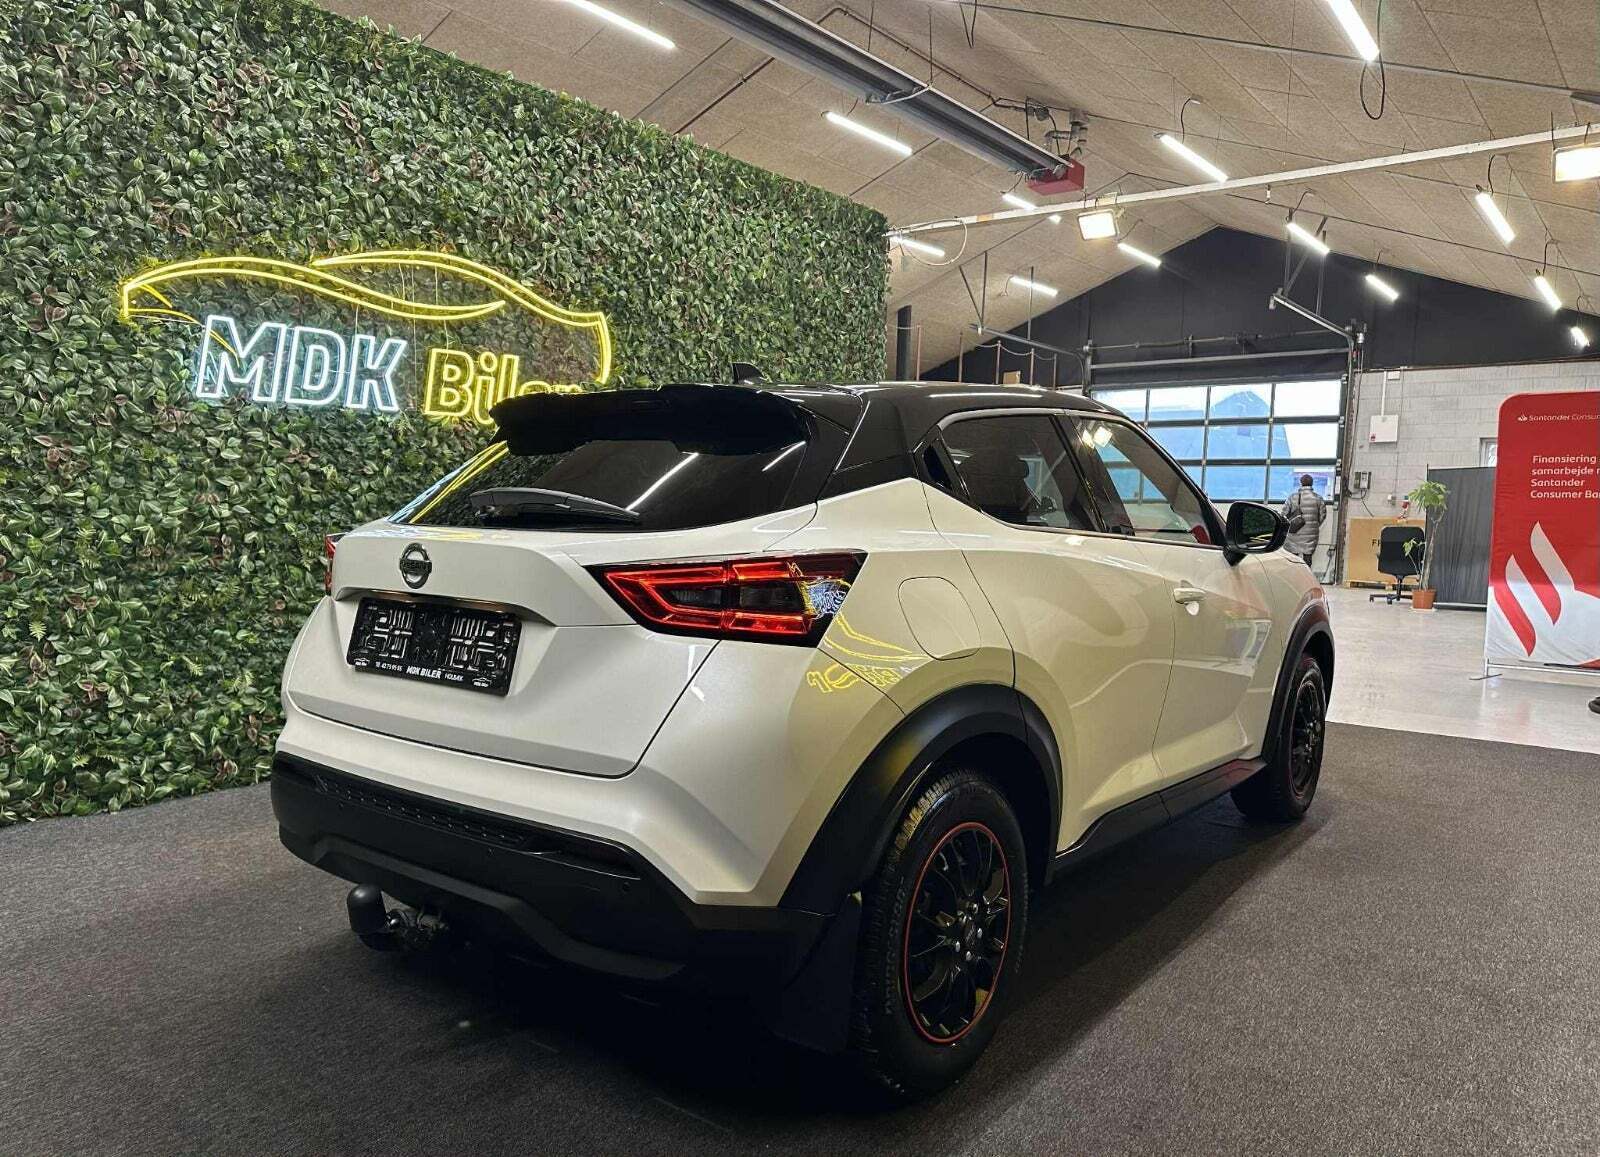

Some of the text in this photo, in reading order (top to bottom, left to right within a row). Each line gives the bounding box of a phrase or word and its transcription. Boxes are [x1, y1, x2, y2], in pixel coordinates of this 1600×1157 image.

[195, 314, 584, 425] MDK Bil
[1532, 455, 1597, 465] Finansiering
[1531, 466, 1594, 476] samarbejde
[1530, 478, 1585, 487] Santander
[1530, 490, 1600, 499] Consumer Ba
[420, 667, 442, 679] BILER
